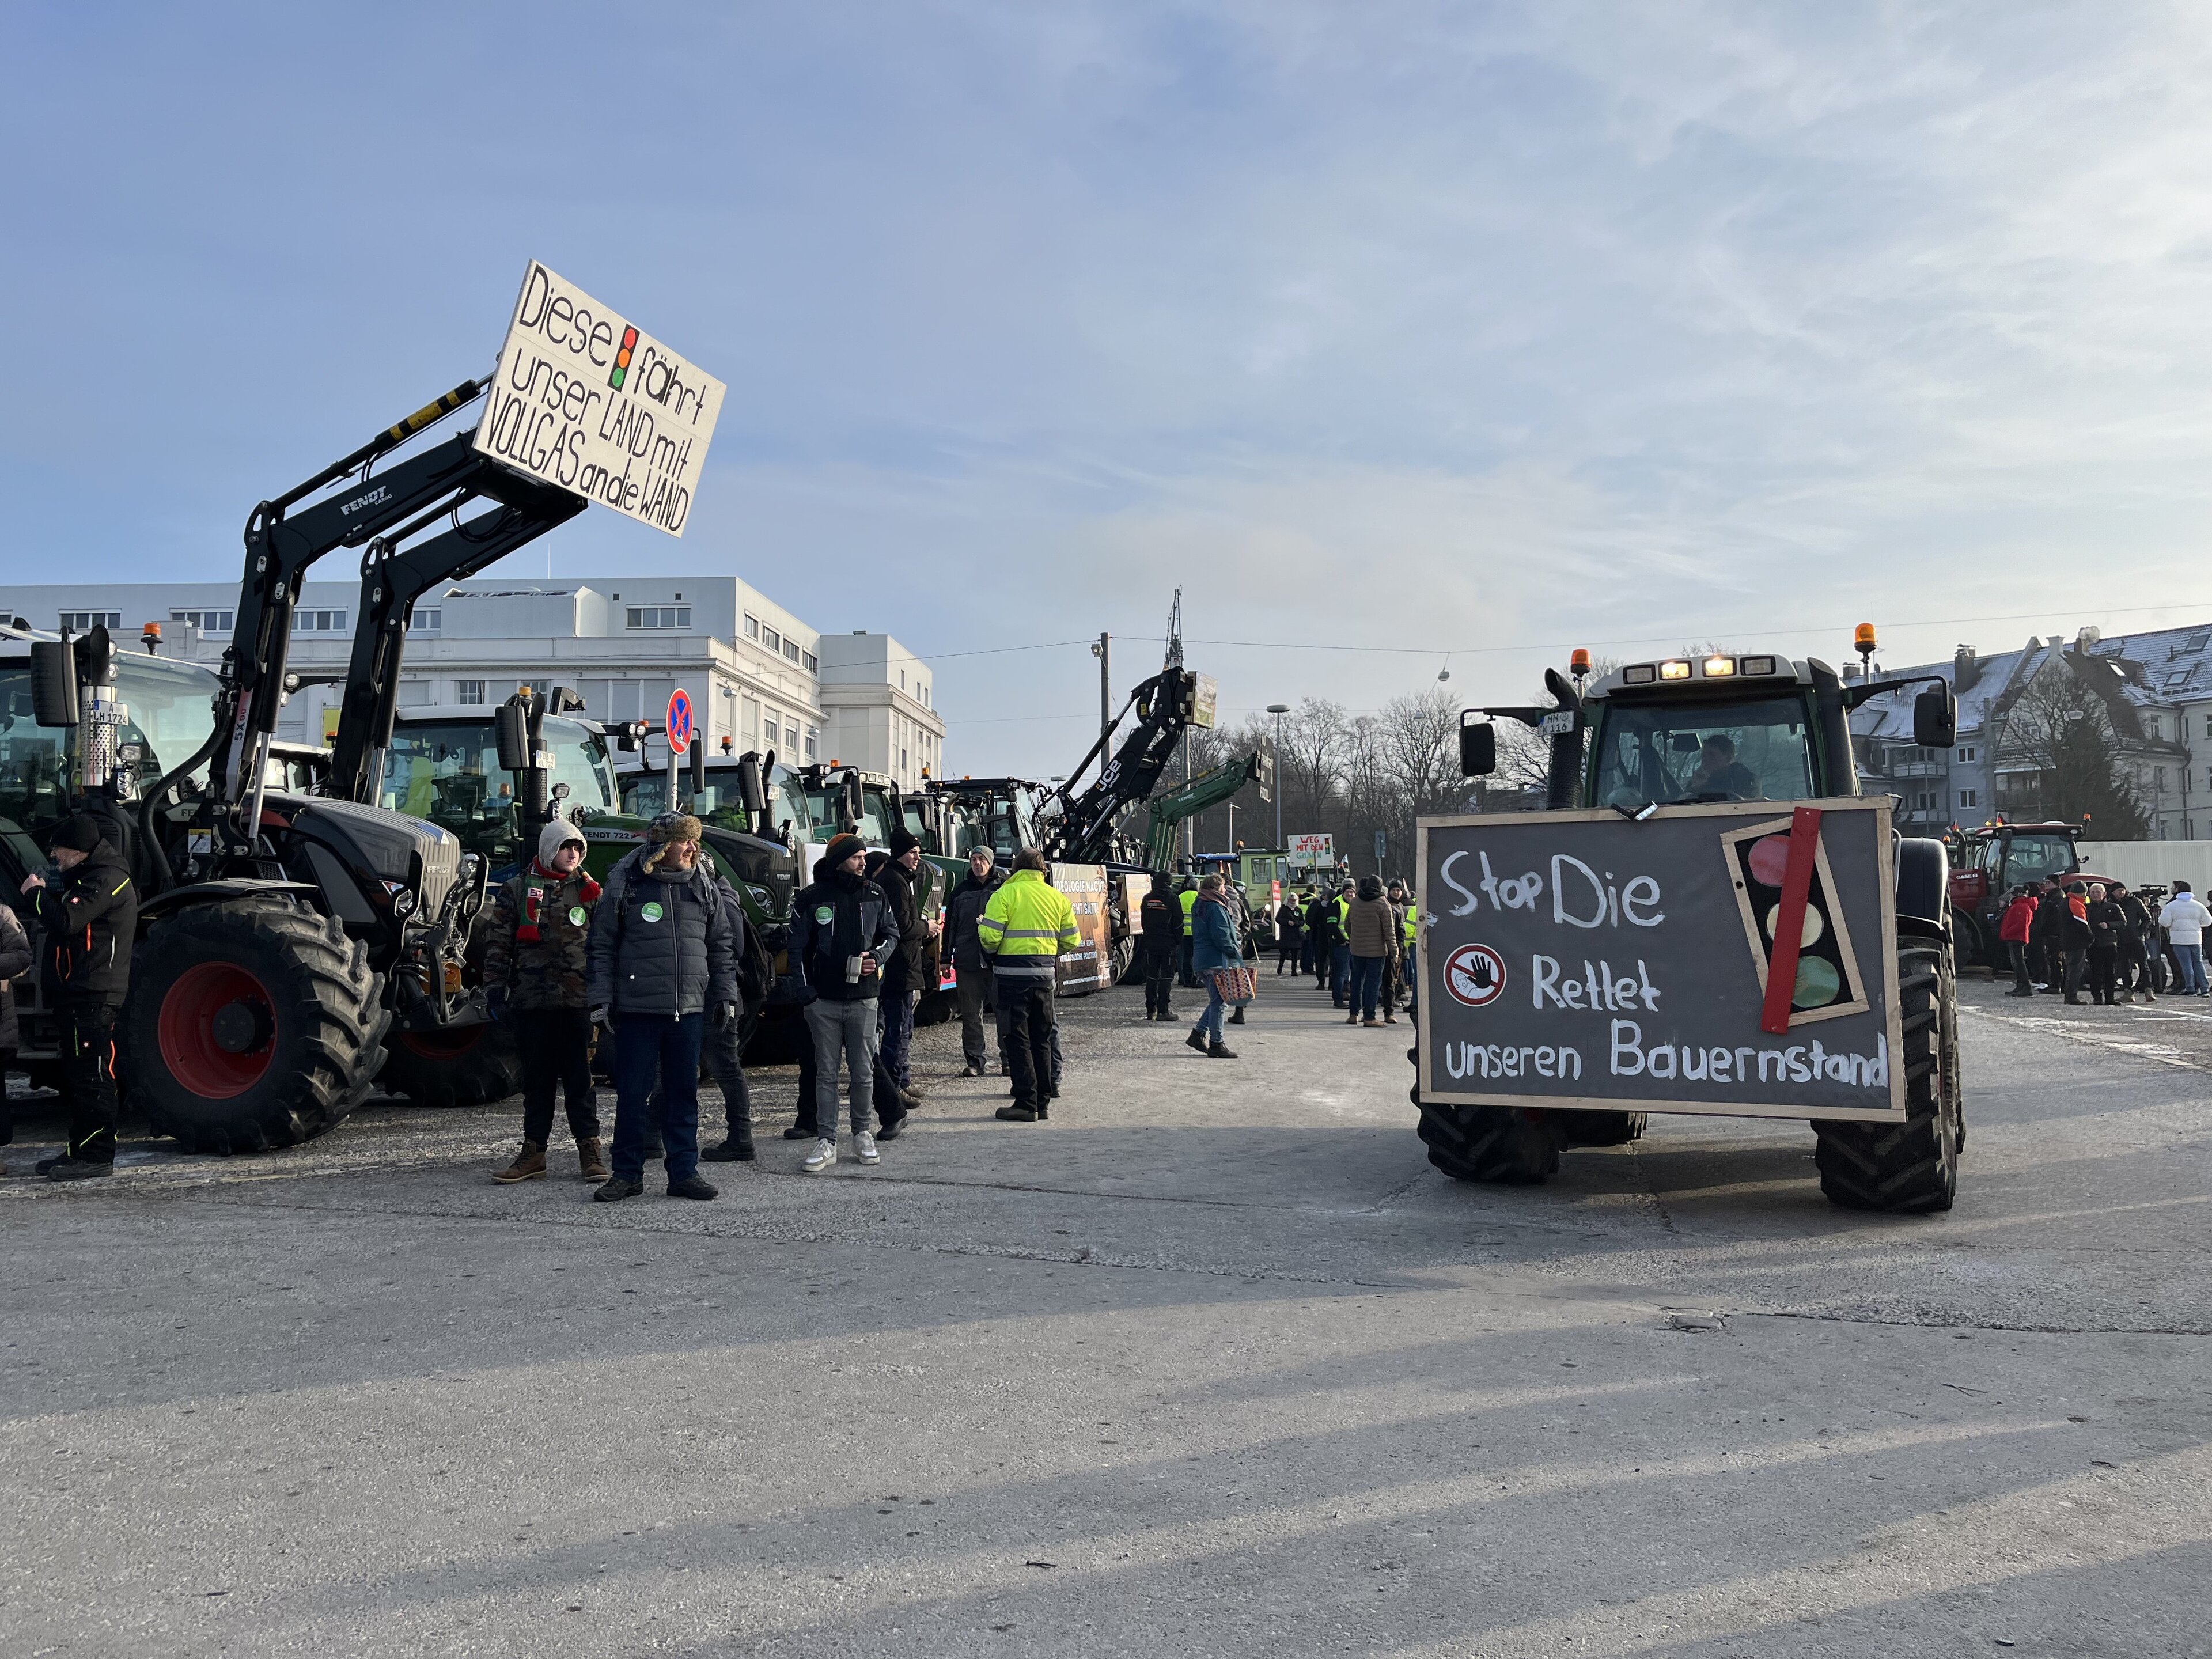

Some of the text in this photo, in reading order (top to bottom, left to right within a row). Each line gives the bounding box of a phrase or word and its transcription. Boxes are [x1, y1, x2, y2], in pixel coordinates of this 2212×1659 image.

[519, 263, 707, 425] Diese fährt
[511, 347, 601, 426] unser
[598, 392, 654, 459] LAND
[649, 433, 692, 481] mit
[487, 386, 586, 486] VOLLGAS
[639, 468, 688, 531] WAND
[340, 485, 387, 516] FENDT
[374, 494, 392, 505] CARGO
[94, 711, 105, 721] LH
[109, 703, 113, 713] A
[1550, 722, 1567, 733] 116
[1099, 759, 1122, 792] JCB
[1296, 851, 1322, 859] GRÜNN
[1054, 879, 1105, 893] IDEOLOGIE MACHT
[1440, 851, 1666, 929] Stop Die
[1072, 902, 1083, 915] CHT
[1532, 954, 1661, 1012] Rettet
[1446, 1041, 1582, 1081] unseren
[1610, 1018, 1889, 1088] Bauernstand
